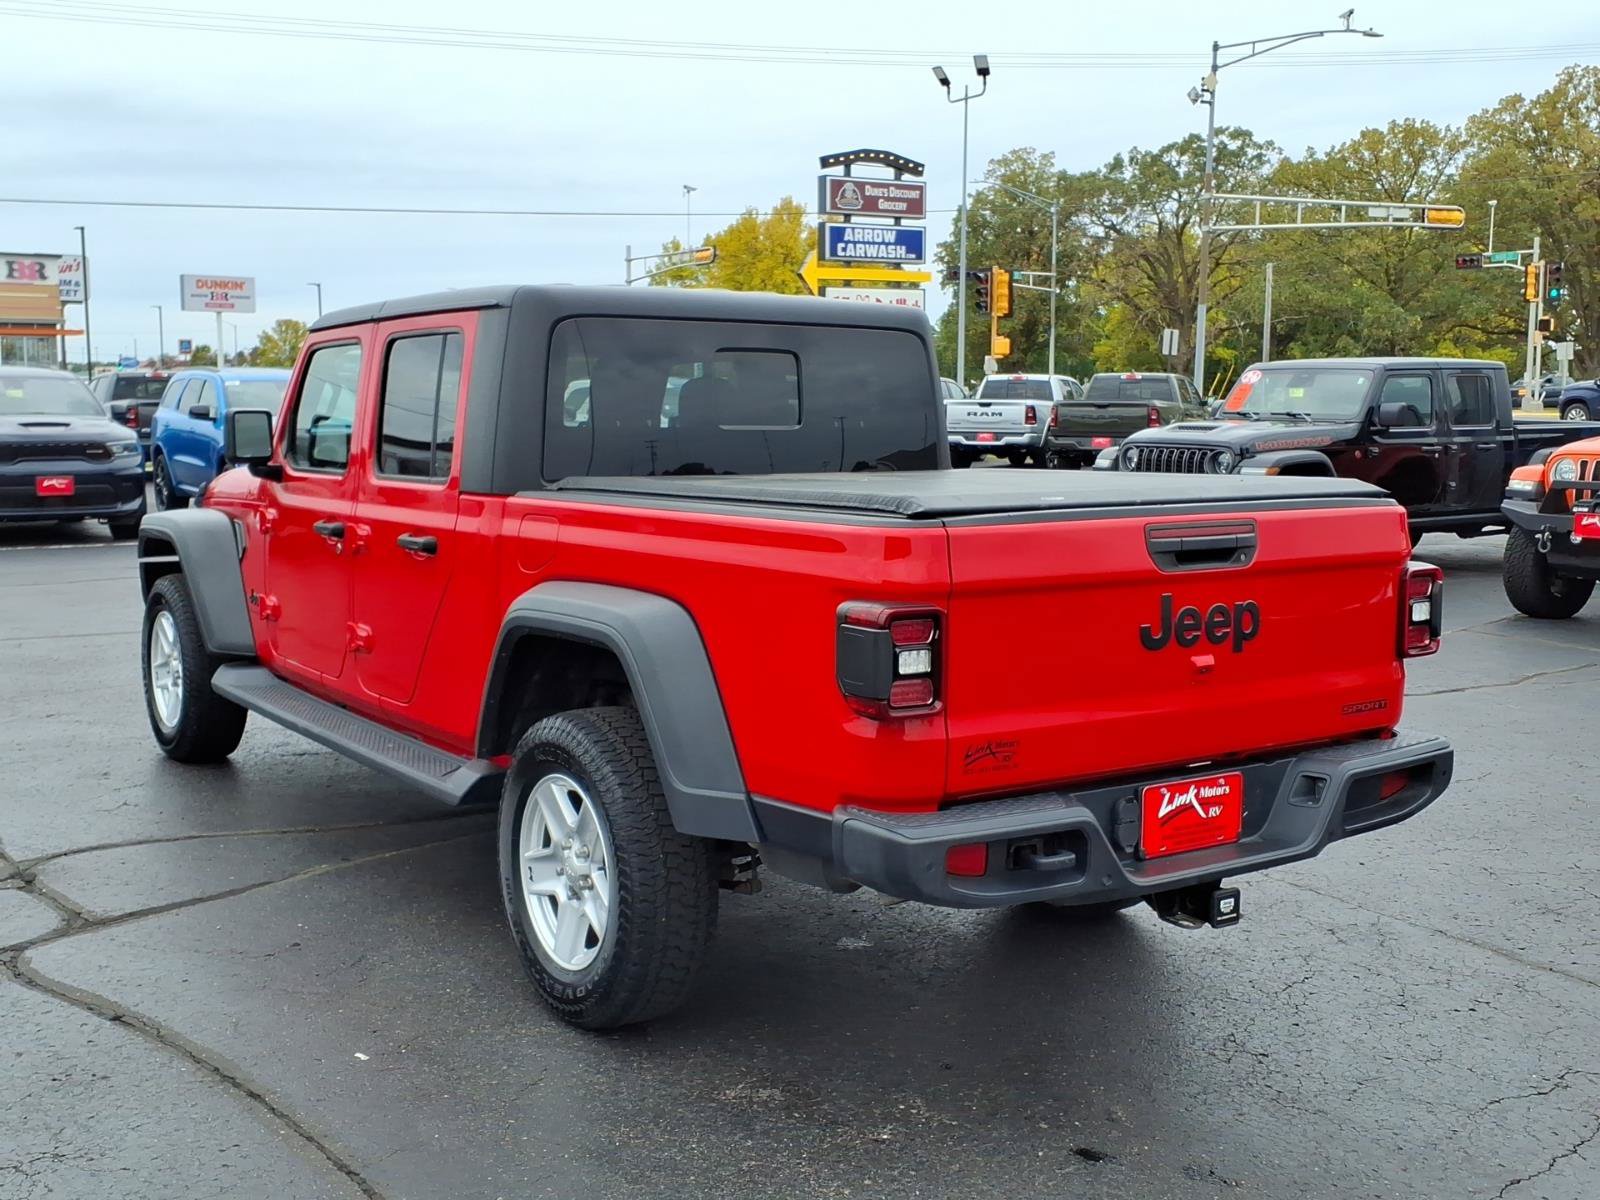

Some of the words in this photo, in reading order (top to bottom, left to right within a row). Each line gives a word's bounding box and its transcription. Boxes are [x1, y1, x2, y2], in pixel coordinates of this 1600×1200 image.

[844, 228, 896, 242] ARROW
[1140, 592, 1261, 653] Jeep
[1342, 699, 1387, 715] SPORT
[1158, 784, 1208, 818] Link
[1199, 785, 1231, 799] Motors
[1208, 805, 1224, 818] RV
